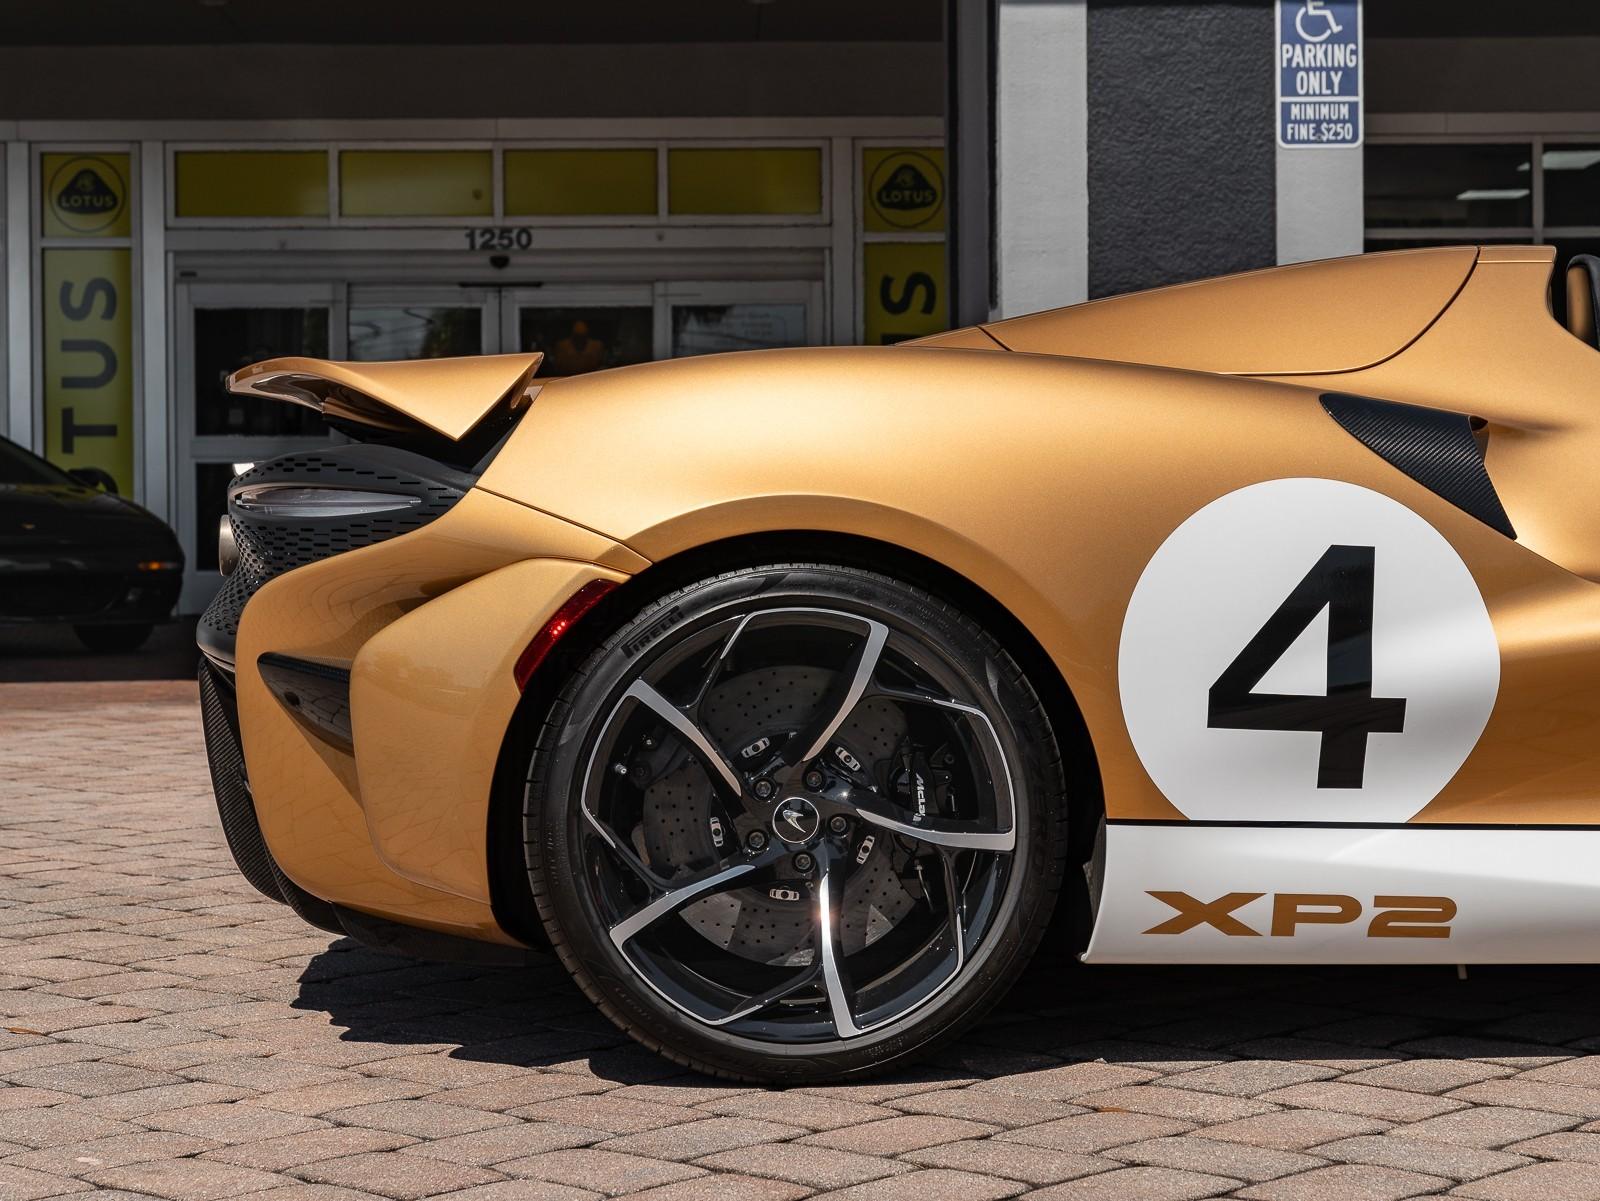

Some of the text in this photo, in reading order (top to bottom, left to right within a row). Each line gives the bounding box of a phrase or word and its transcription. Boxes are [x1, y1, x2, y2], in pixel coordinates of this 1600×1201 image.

[1281, 43, 1357, 68] PARKING
[1295, 71, 1343, 95] ONLY
[1290, 103, 1349, 120] MINIMUM
[1286, 122, 1353, 142] FINE $250
[60, 193, 115, 208] LOTUS
[881, 190, 933, 203] LOTUS
[464, 227, 533, 250] 1250
[620, 605, 684, 659] PIRELLI
[1207, 544, 1407, 789] 4
[1140, 890, 1457, 938] XP2
